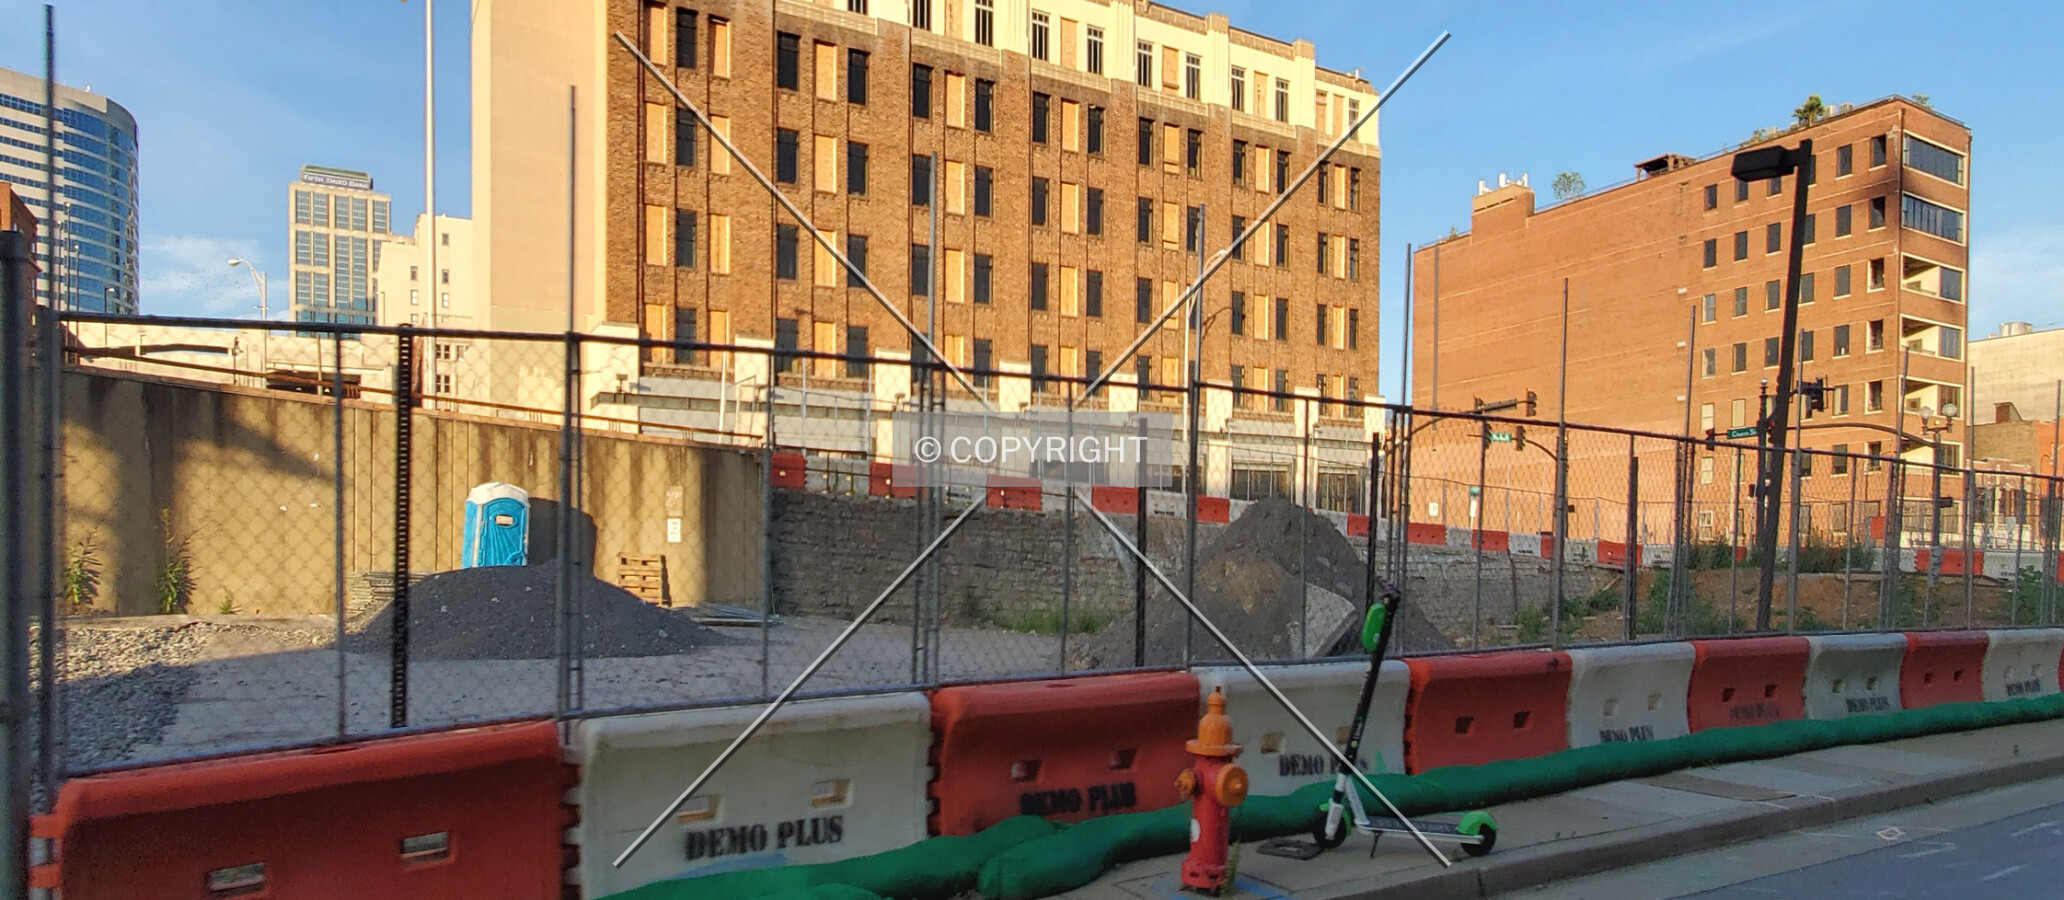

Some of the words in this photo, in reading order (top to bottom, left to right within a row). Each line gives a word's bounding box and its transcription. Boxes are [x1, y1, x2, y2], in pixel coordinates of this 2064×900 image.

[326, 177, 348, 186] THIRD
[349, 180, 369, 189] BANK
[1278, 754, 1324, 776] DEMO
[1019, 787, 1083, 815] DEMO
[1087, 781, 1136, 812] PLUS
[685, 823, 768, 860] DEMO
[777, 815, 844, 848] PLUS
